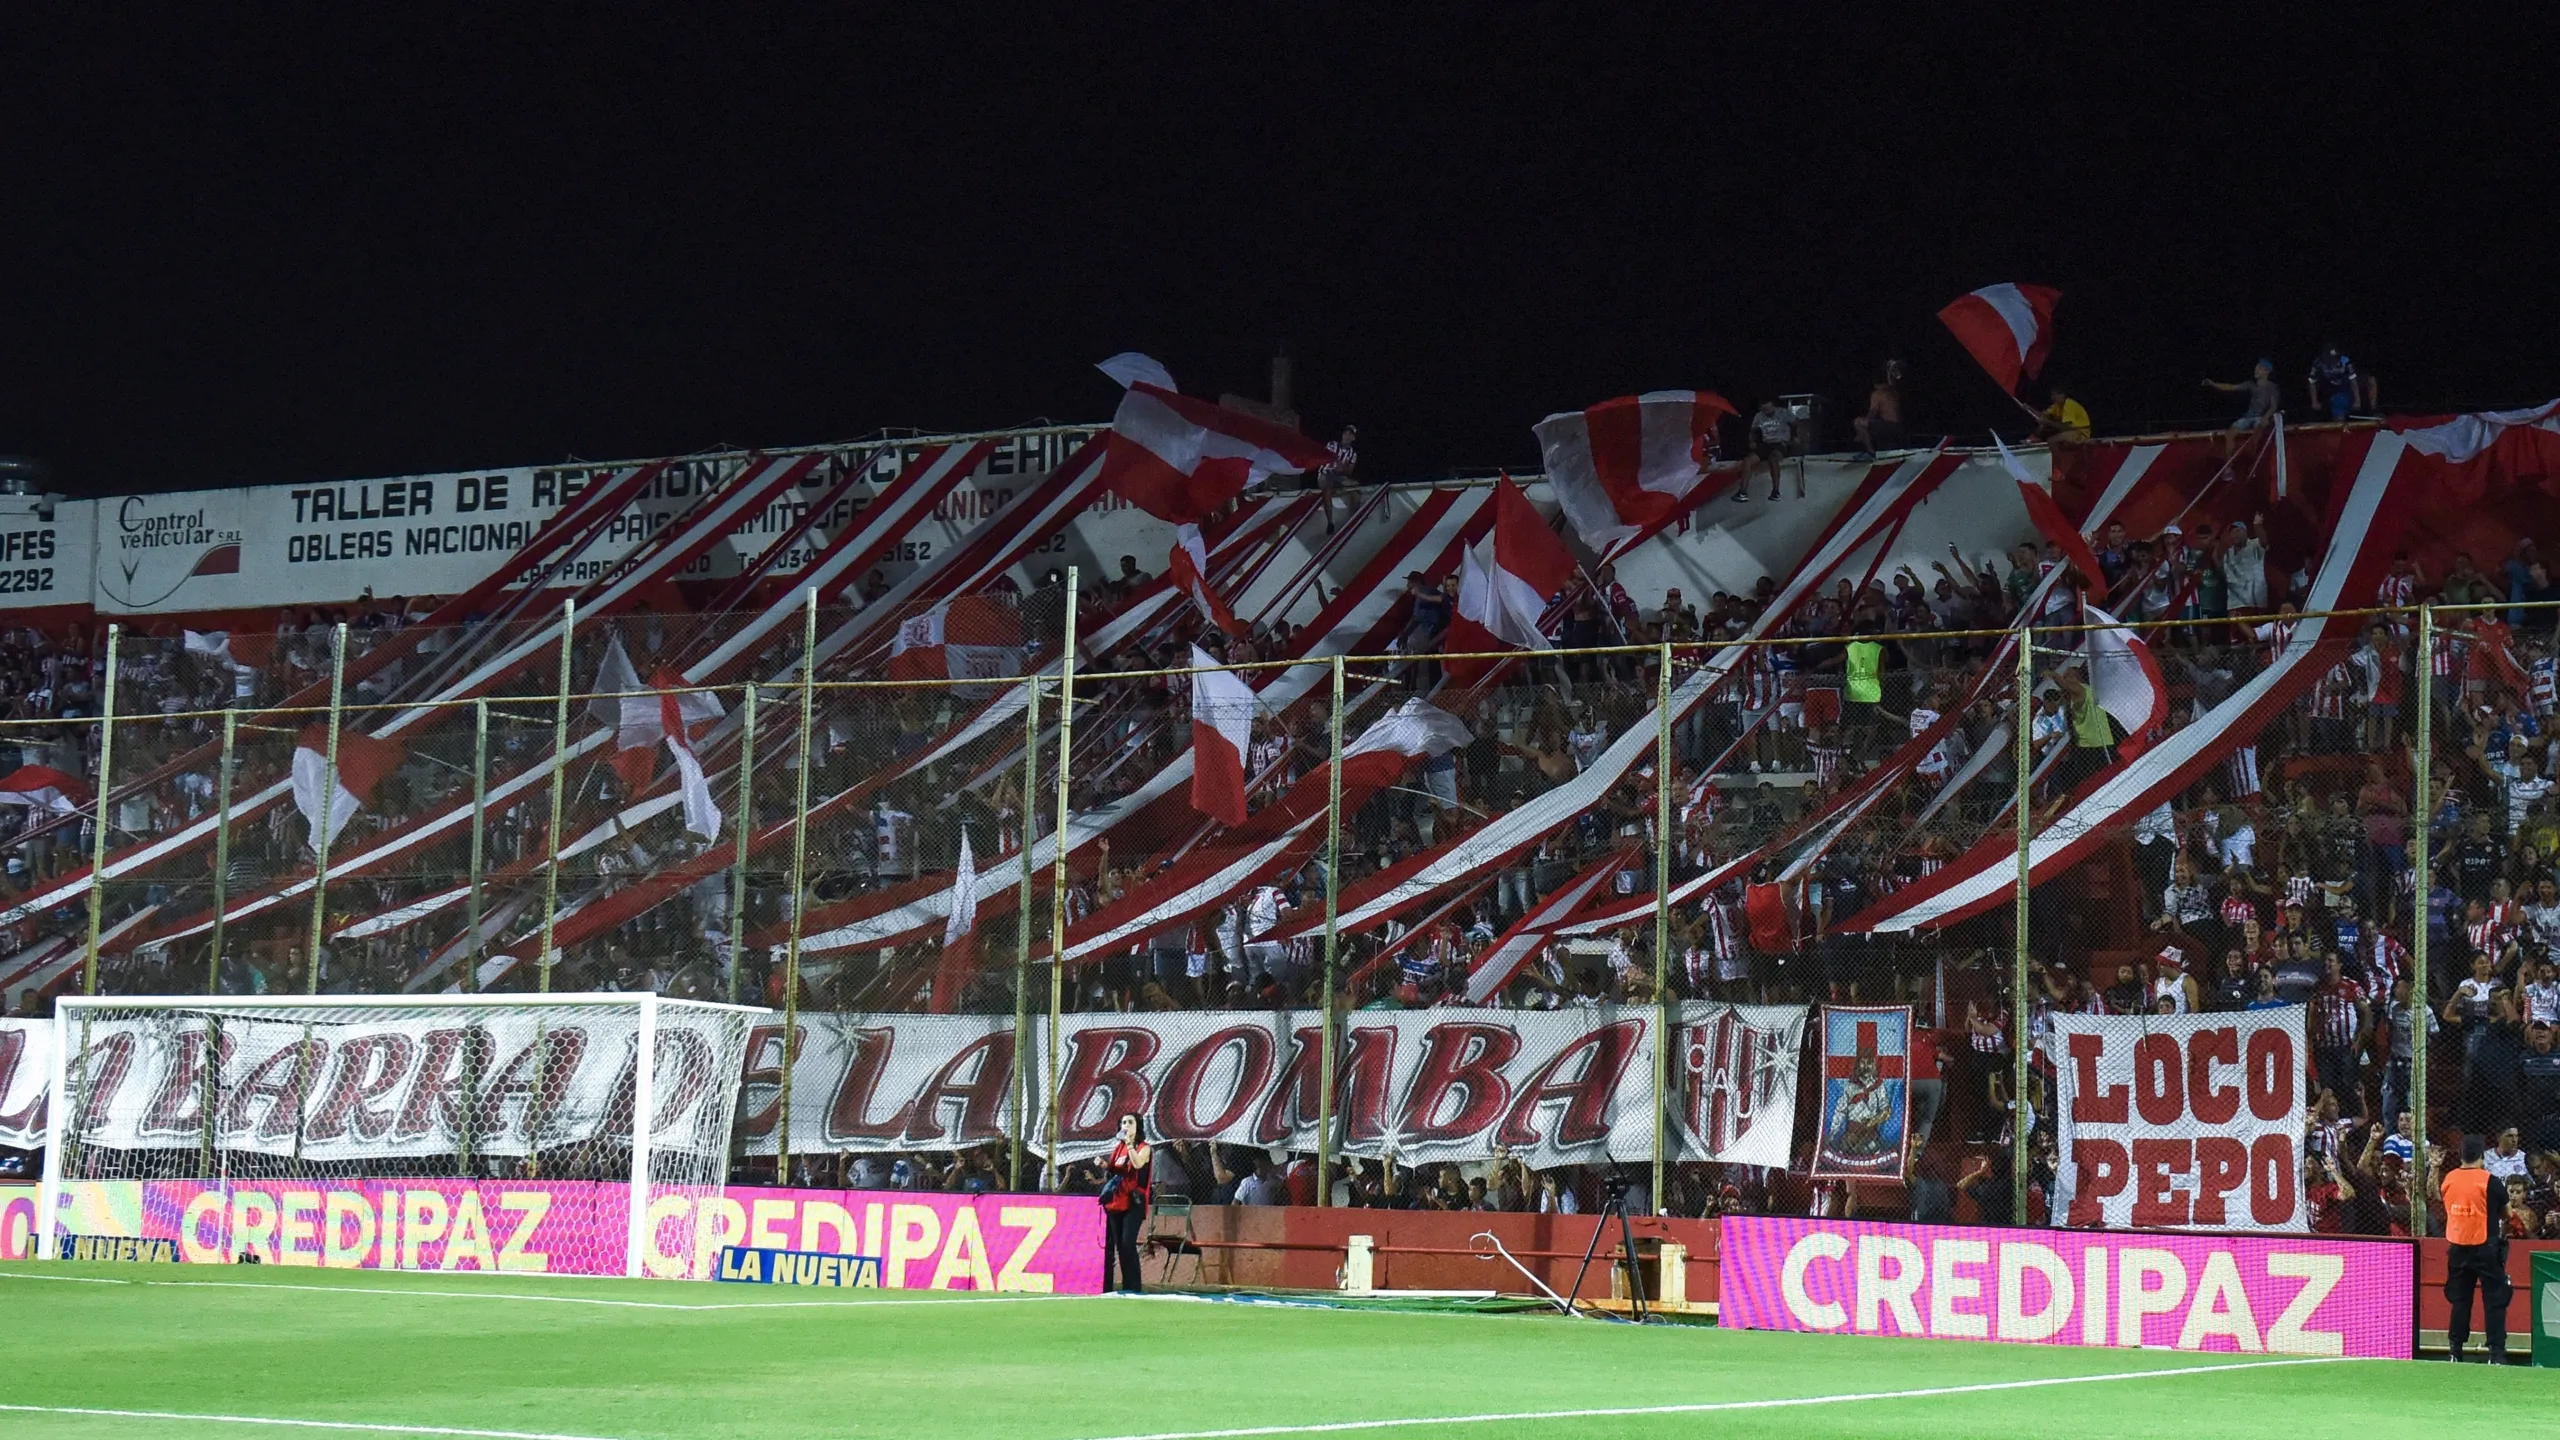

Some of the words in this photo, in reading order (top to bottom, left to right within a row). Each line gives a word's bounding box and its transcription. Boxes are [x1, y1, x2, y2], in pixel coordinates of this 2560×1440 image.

[118, 496, 204, 532] Control
[292, 480, 433, 523] TALLER
[457, 476, 508, 512] DE
[0, 530, 55, 561] FES
[120, 527, 214, 549] vehicular
[289, 530, 392, 563] OBLEAS
[406, 520, 575, 556] NACIONAL
[142, 1026, 589, 1144] BARRA
[829, 1025, 1016, 1142] LA
[1057, 1018, 1646, 1146] BOMBA
[2069, 1026, 2294, 1126] LOCO
[2067, 1132, 2297, 1227] PEPO
[74, 1238, 174, 1263] NUEVA
[181, 1188, 552, 1271] CREDIPAZ
[641, 1195, 1057, 1294] CREDIPAZ
[720, 1249, 764, 1282] LA
[771, 1252, 880, 1289] NUEVA
[1780, 1231, 2345, 1357] CREDIPAZ
